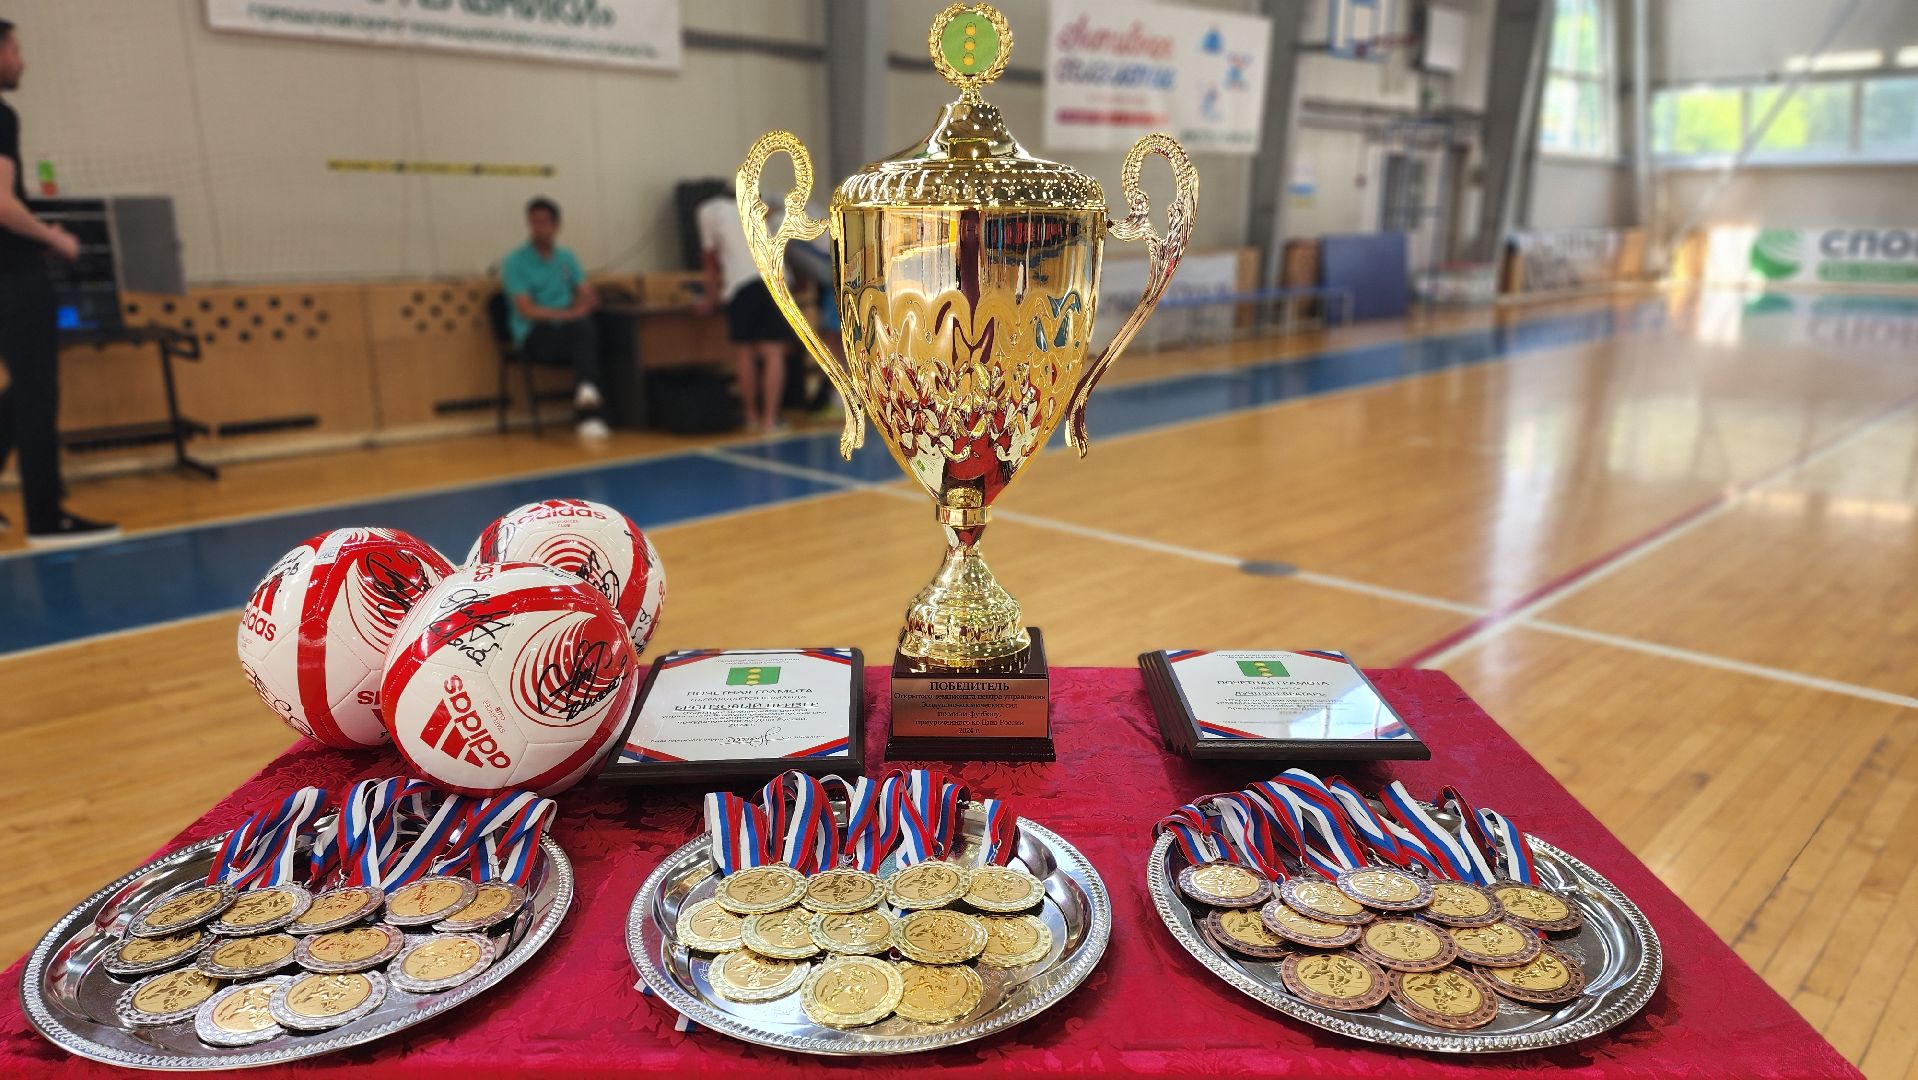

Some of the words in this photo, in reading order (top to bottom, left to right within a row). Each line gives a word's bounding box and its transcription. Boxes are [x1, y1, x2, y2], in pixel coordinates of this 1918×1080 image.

[517, 505, 607, 525] adidas
[930, 681, 1010, 692] ПОБЕДИТЕЛЬ
[443, 674, 511, 769] adidas
